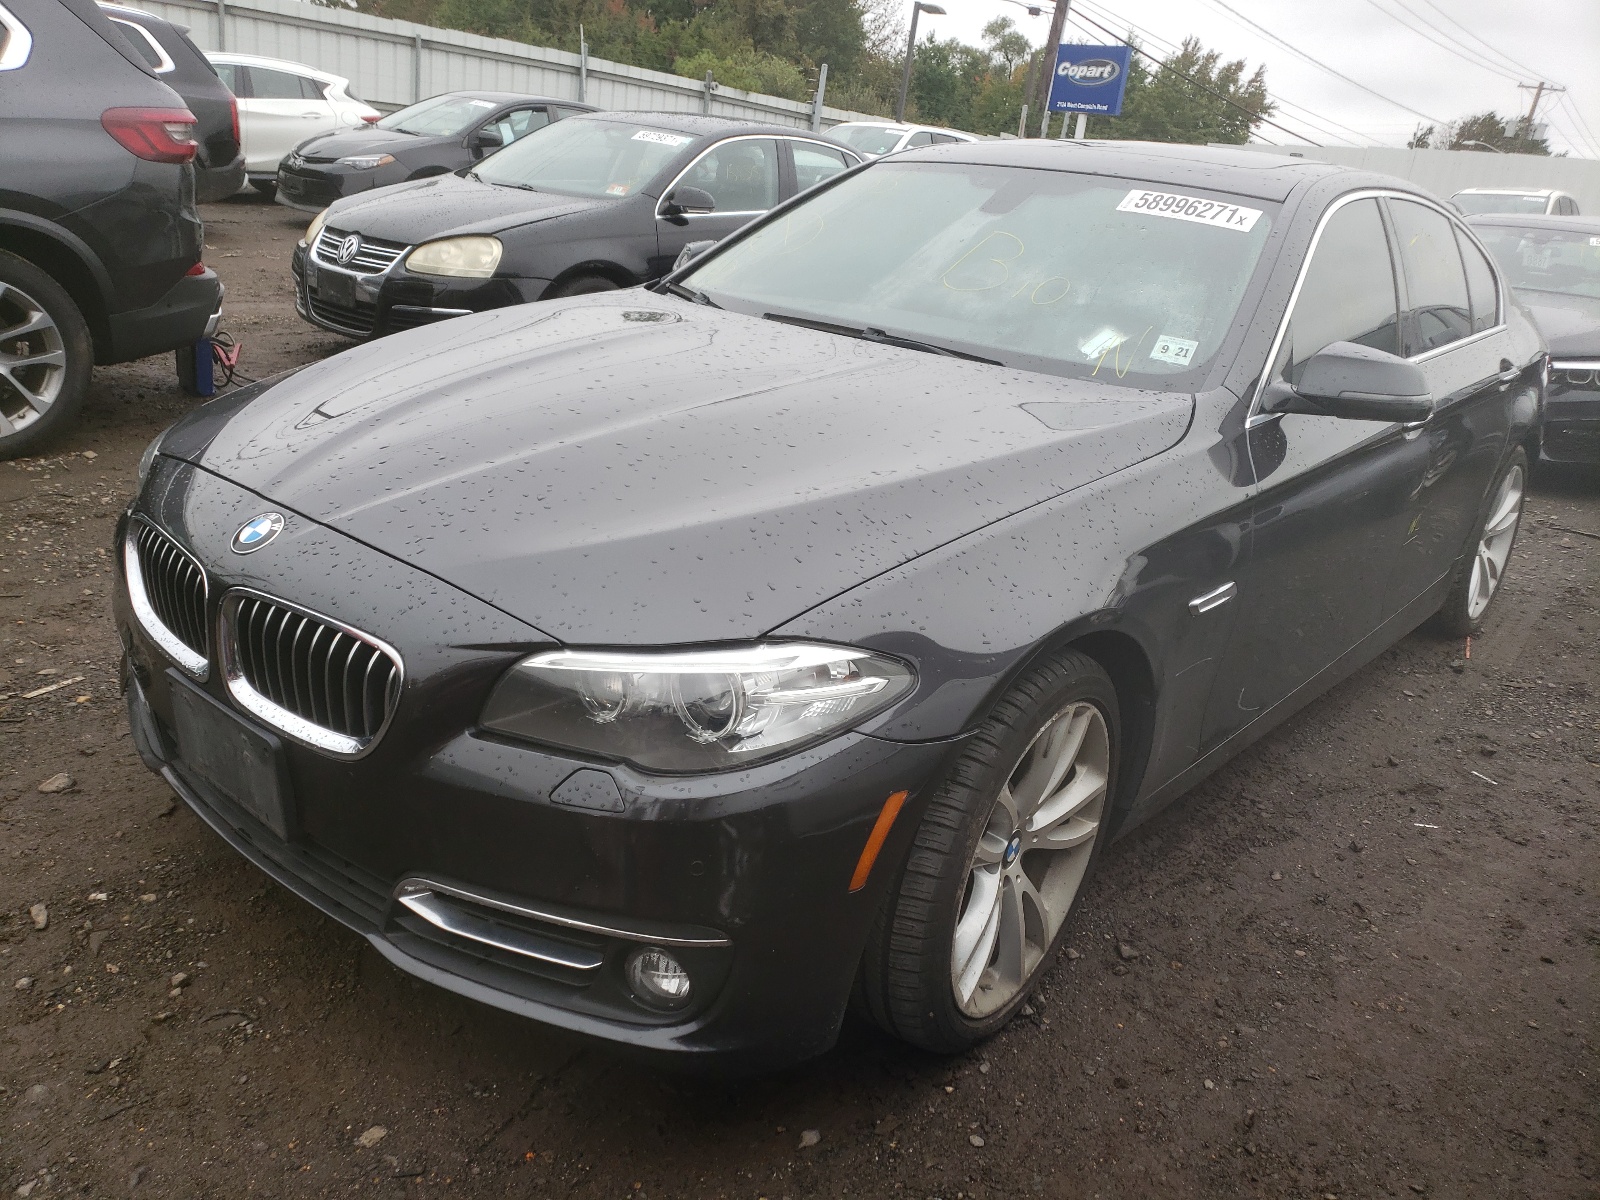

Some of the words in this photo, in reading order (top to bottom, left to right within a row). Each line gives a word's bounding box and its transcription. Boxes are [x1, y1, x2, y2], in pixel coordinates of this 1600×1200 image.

[1058, 61, 1112, 79] Copart
[1160, 344, 1170, 354] 9
[1174, 346, 1190, 358] 21
